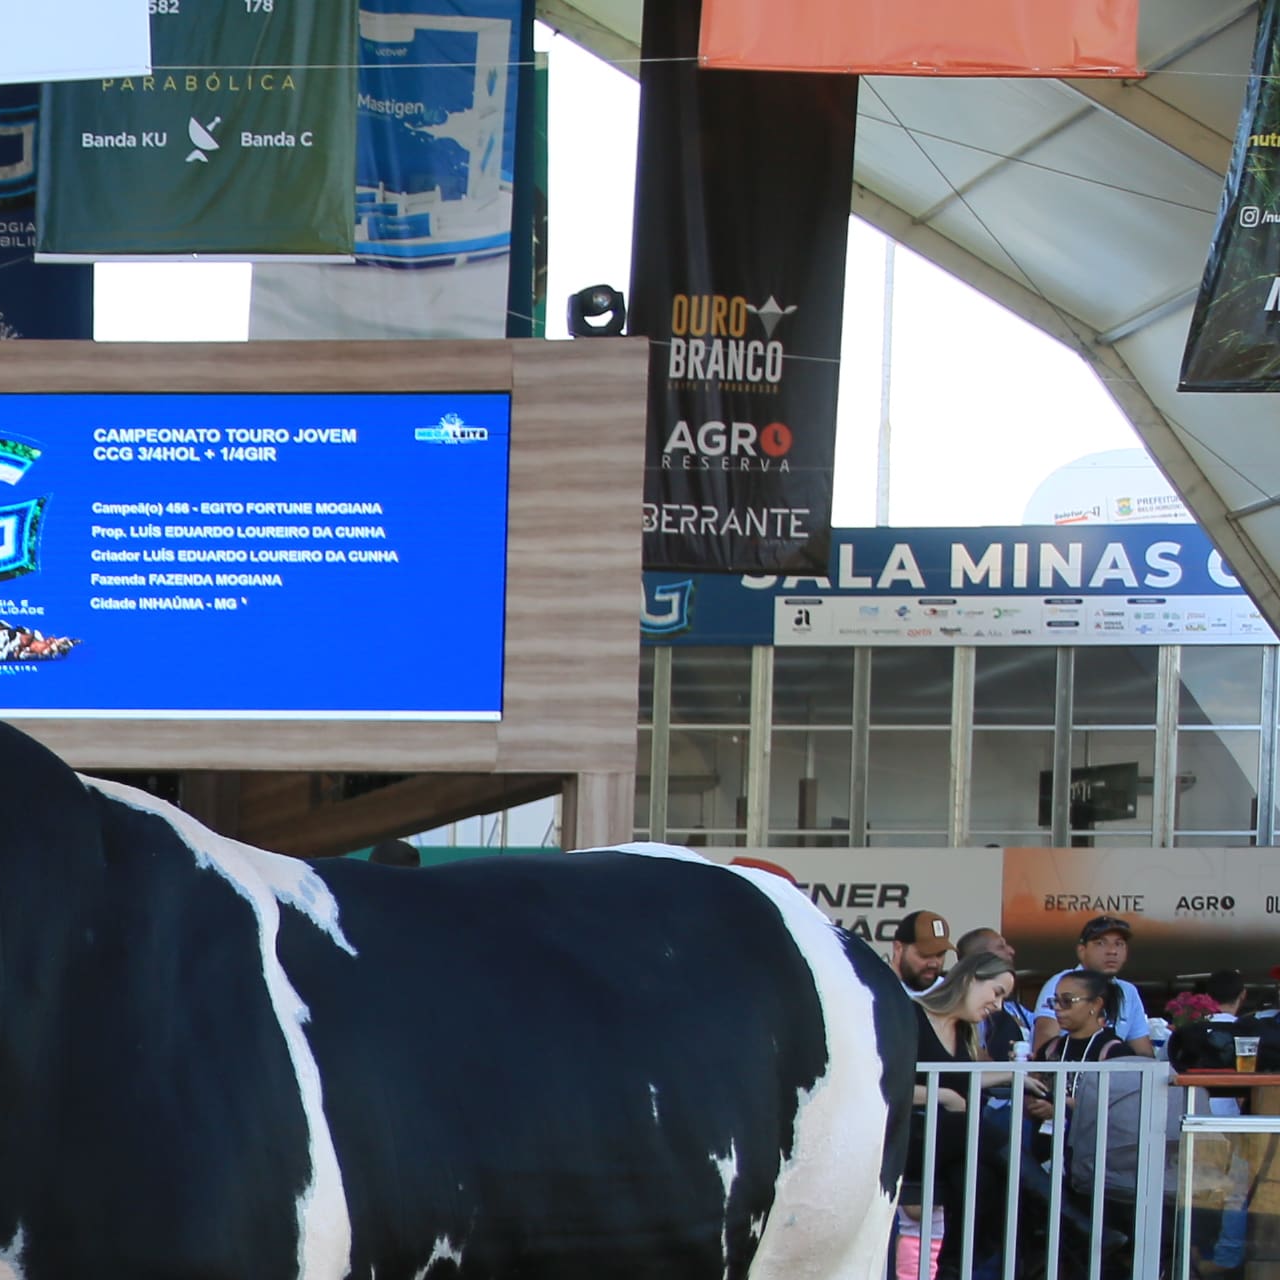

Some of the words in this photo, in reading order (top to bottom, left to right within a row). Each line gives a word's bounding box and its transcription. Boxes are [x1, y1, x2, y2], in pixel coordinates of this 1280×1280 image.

[101, 71, 297, 92] PARABÓLICA
[357, 92, 425, 118] Mastigen
[81, 132, 137, 149] Banda
[141, 132, 168, 148] KU
[240, 131, 296, 148] Banda
[300, 131, 313, 147] C
[671, 293, 748, 338] OURO
[668, 336, 784, 383] BRANCO
[93, 428, 221, 443] CAMPEONATO
[224, 428, 289, 443] TOURO
[292, 428, 357, 443] JOVEM
[92, 446, 134, 461] CCG
[137, 446, 200, 462] 3/4HOL
[219, 446, 277, 462] 1/4GIR
[661, 455, 790, 473] RESERVA
[200, 503, 244, 515] EGITO
[246, 503, 313, 515] FORTUNE
[315, 503, 383, 515] MOGIANA
[91, 526, 127, 540] Prop.
[164, 526, 234, 539] EDUARDO
[236, 526, 310, 539] LOUREIRO
[312, 526, 333, 539] DA
[335, 526, 386, 539] CUNHA
[91, 549, 141, 562] Criador
[177, 550, 248, 562] EDUARDO
[249, 550, 323, 562] LOUREIRO
[325, 550, 346, 562] DA
[348, 550, 399, 563] CUNHA
[948, 541, 1183, 590] MINAS
[90, 573, 146, 586] Fazenda
[148, 573, 214, 586] FAZENDA
[215, 573, 283, 586] MOGIANA
[90, 597, 137, 610] Cidade
[214, 597, 238, 610] MG
[796, 882, 910, 909] NER
[1044, 894, 1145, 913] BERRANTE
